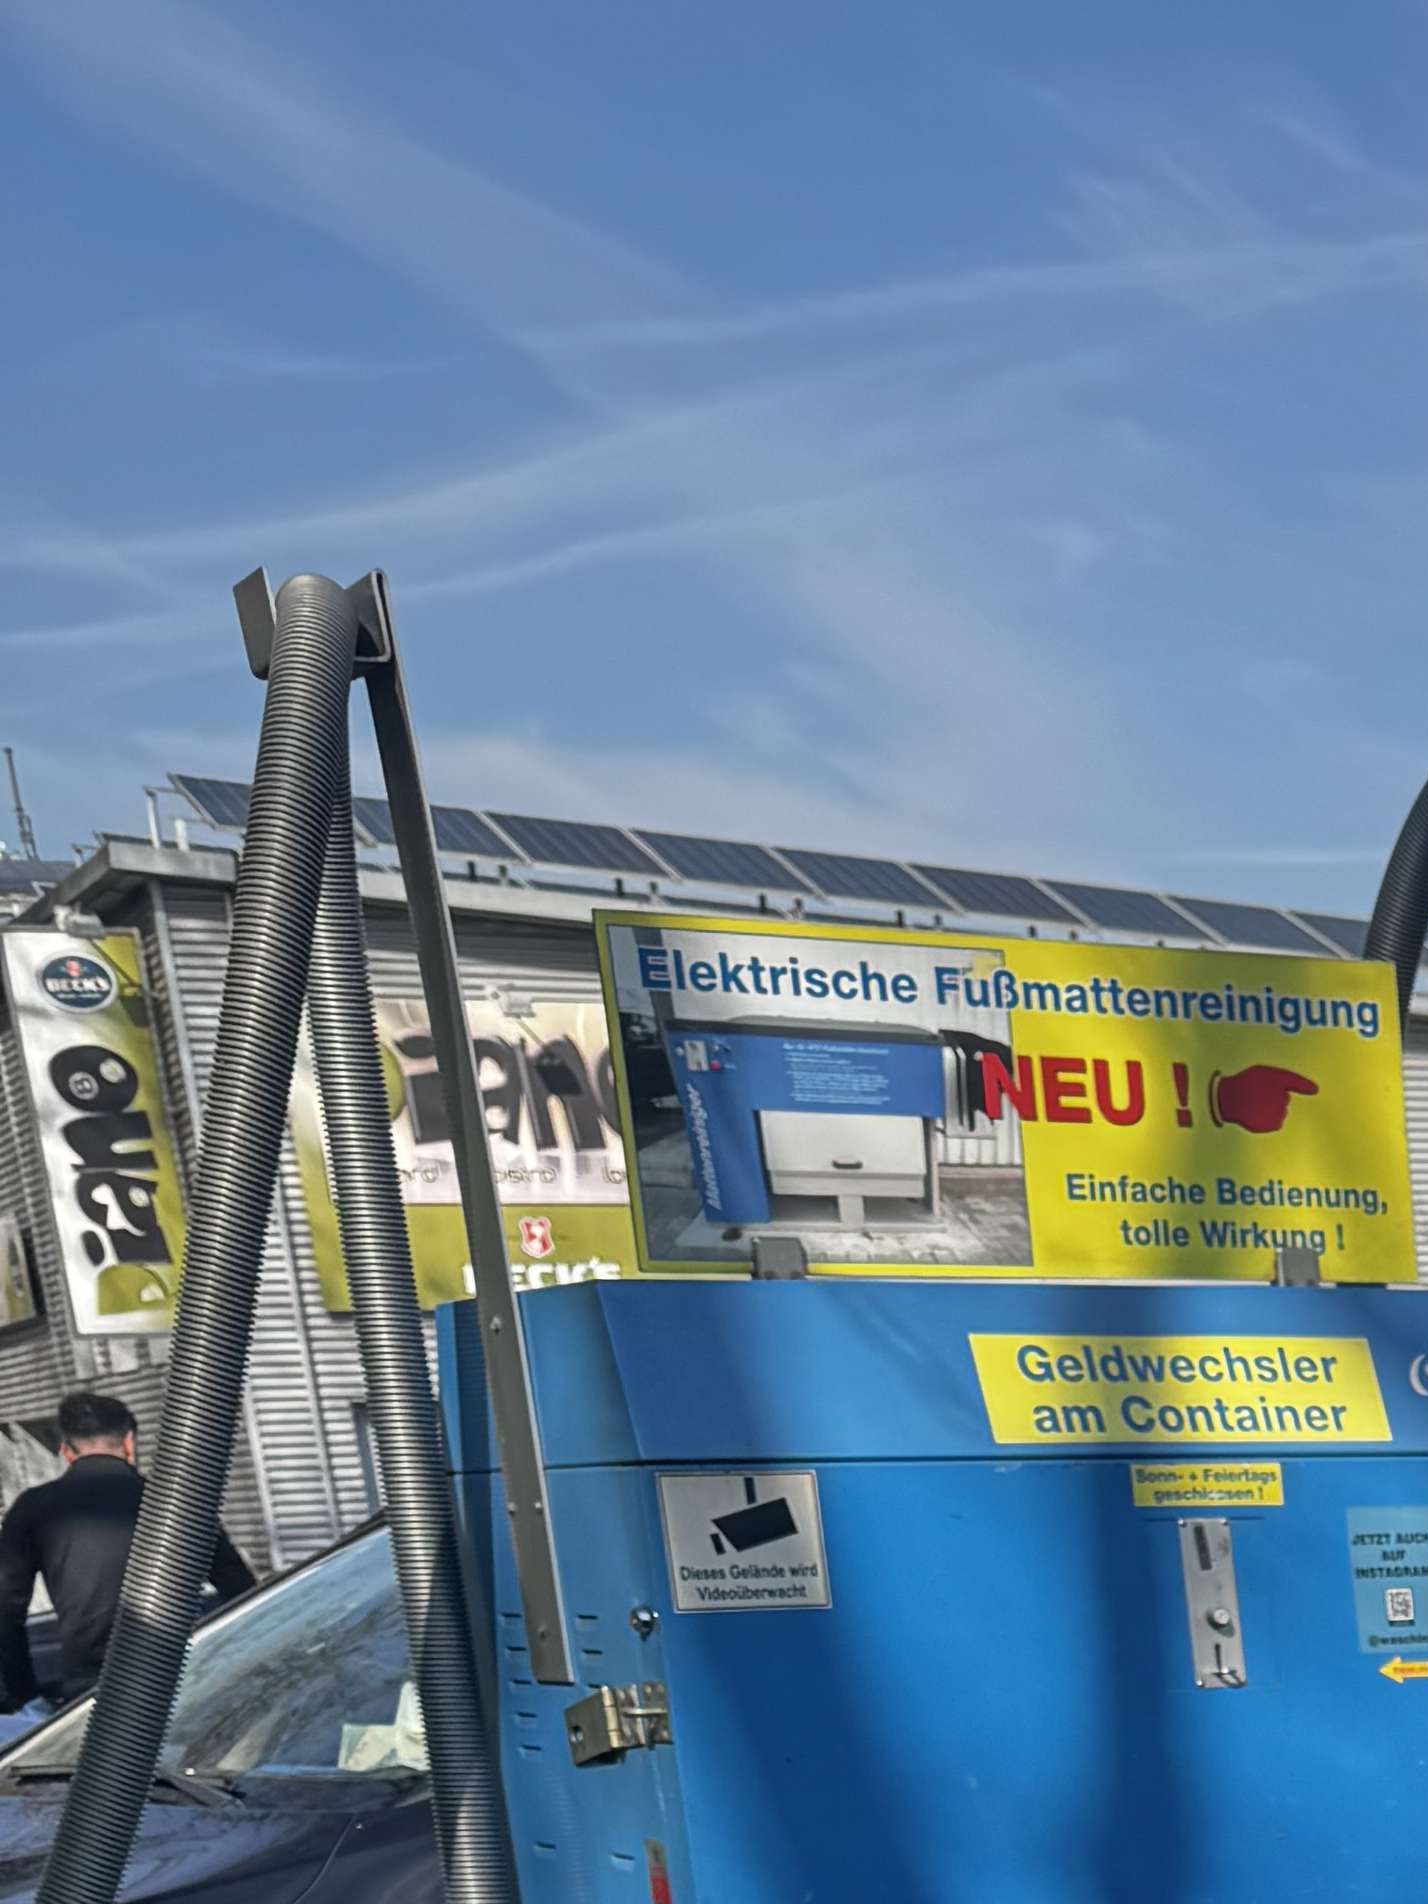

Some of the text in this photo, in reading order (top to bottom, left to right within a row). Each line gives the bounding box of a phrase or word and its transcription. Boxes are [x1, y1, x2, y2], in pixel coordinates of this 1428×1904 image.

[637, 946, 1381, 1038] Elektrische Fußmattenreinigung
[977, 1050, 1146, 1127] NEU
[1173, 1060, 1194, 1128] !
[1066, 1173, 1389, 1215] Einfache Bedienung,
[1120, 1219, 1346, 1254] tolle Wirkung !
[1016, 1344, 1338, 1384] Geldwechsler
[1033, 1396, 1347, 1433] am Container
[1203, 1468, 1278, 1486] Feiertags
[1352, 1533, 1392, 1546] JETZT
[679, 1562, 818, 1581] Dieses Gelände wird
[696, 1584, 807, 1601] Videoüberwacht
